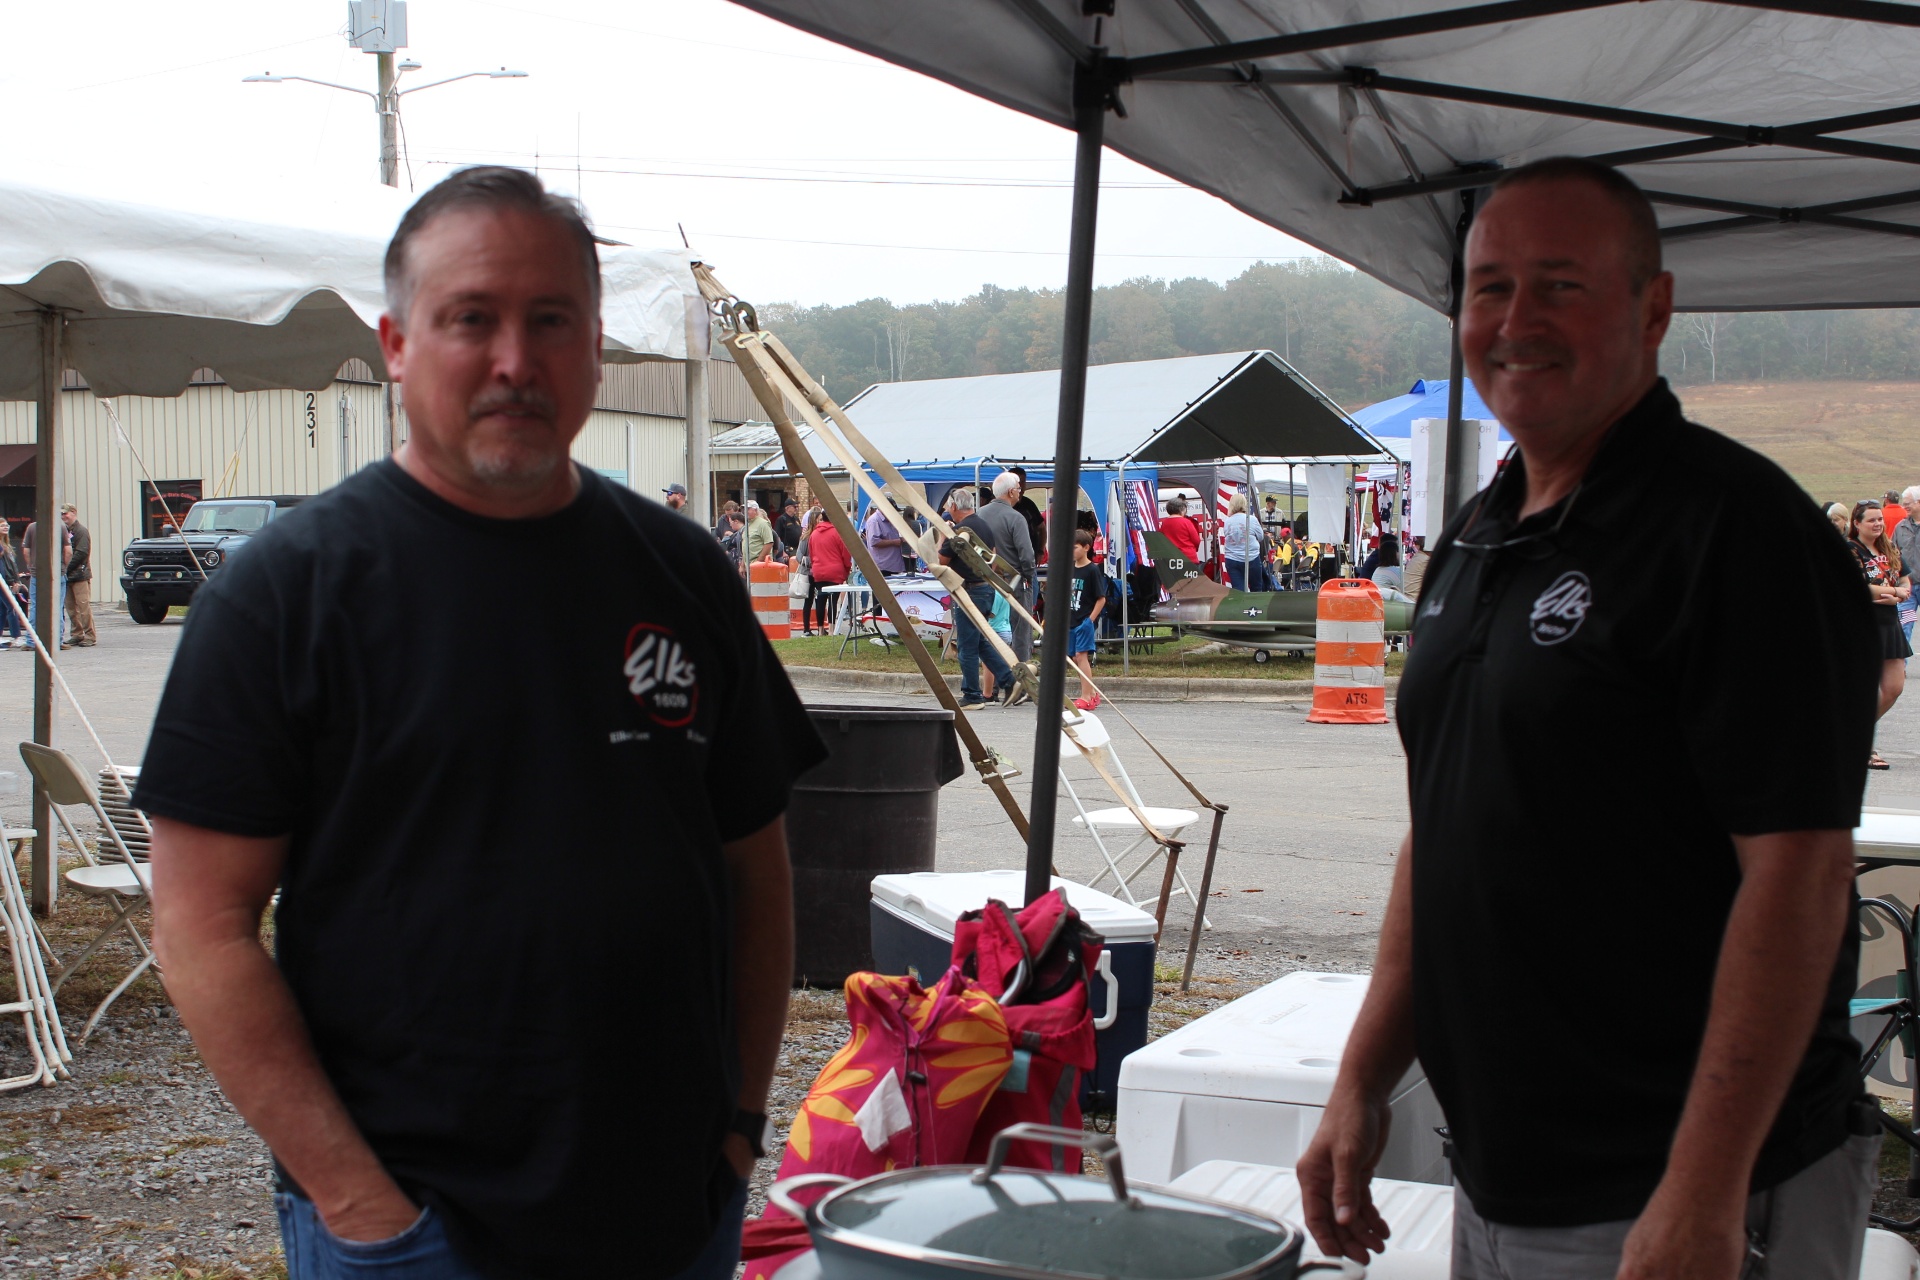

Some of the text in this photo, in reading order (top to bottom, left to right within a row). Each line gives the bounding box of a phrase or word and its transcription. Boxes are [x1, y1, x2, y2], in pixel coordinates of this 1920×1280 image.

[306, 392, 316, 449] 231
[1168, 558, 1184, 570] CB
[1183, 570, 1199, 579] 440
[1529, 579, 1592, 620] Elks
[623, 632, 696, 695] Elks
[1345, 692, 1368, 705] ATS
